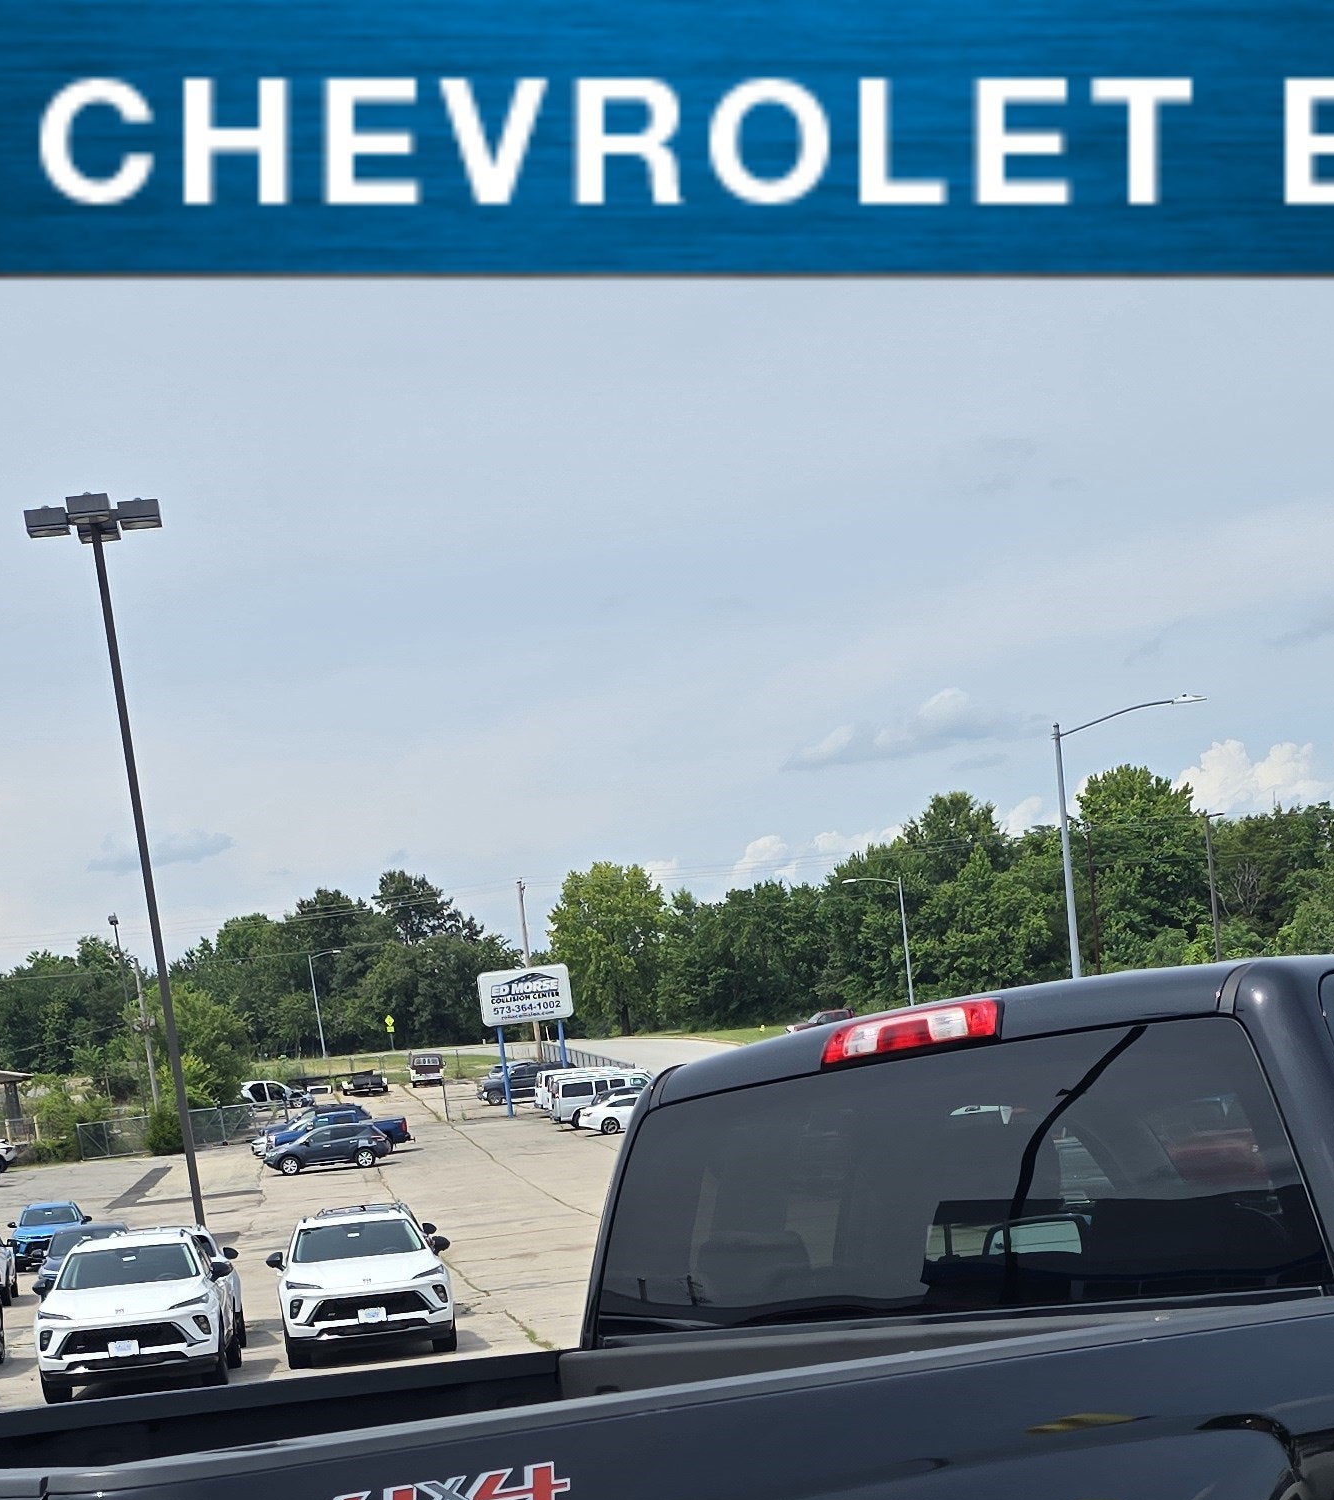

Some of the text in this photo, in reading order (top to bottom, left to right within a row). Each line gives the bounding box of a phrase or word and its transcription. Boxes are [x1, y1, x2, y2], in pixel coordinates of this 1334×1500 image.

[491, 979, 559, 997] ED MORSE
[491, 991, 560, 1005] COLLISION CENTER
[493, 1000, 561, 1015] 573-364-1002
